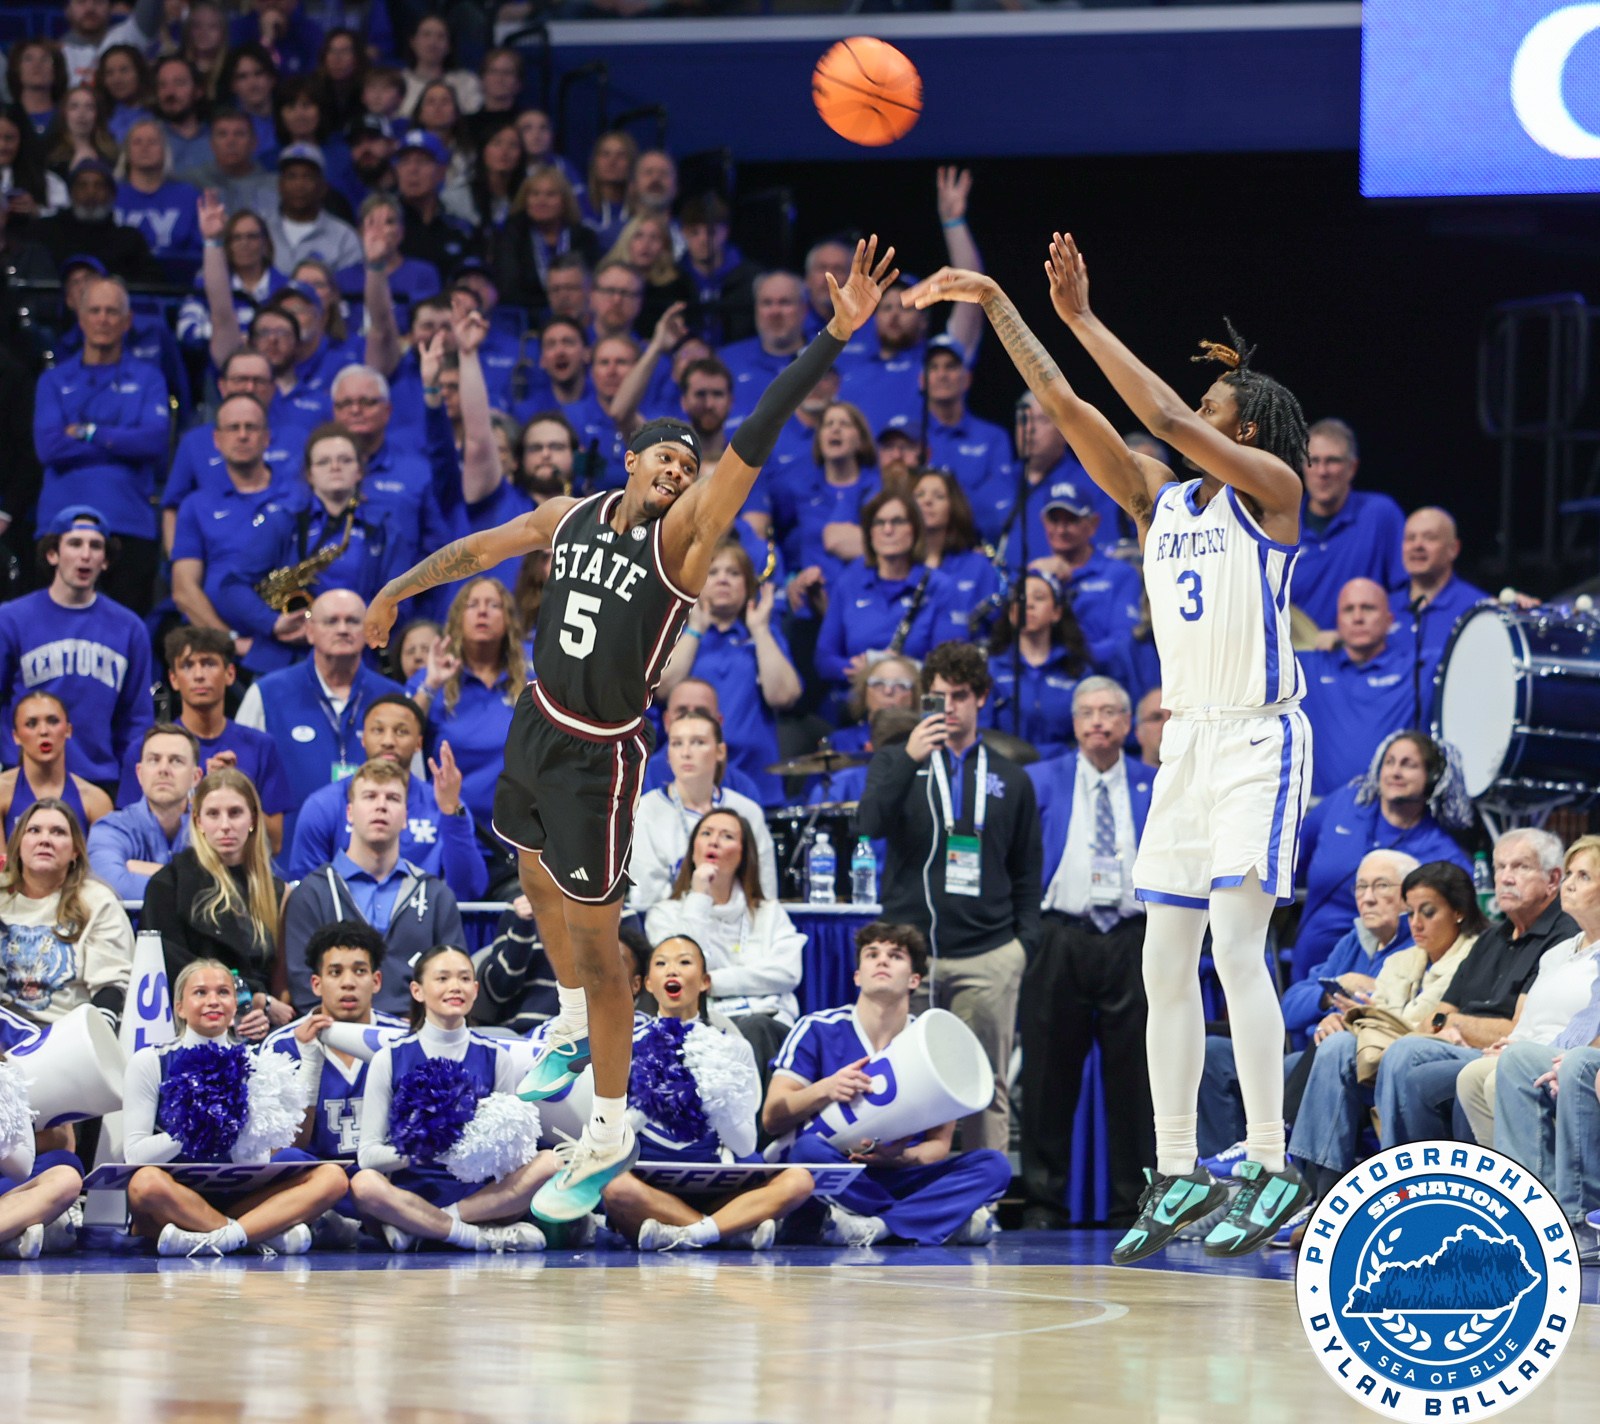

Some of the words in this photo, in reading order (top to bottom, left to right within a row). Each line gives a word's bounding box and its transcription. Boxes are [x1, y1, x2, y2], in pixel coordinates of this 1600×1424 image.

[555, 542, 648, 602] STATE
[1176, 569, 1204, 622] 3
[558, 589, 602, 660] 5
[20, 637, 129, 693] KENTUCKY
[83, 1165, 264, 1190] MSS
